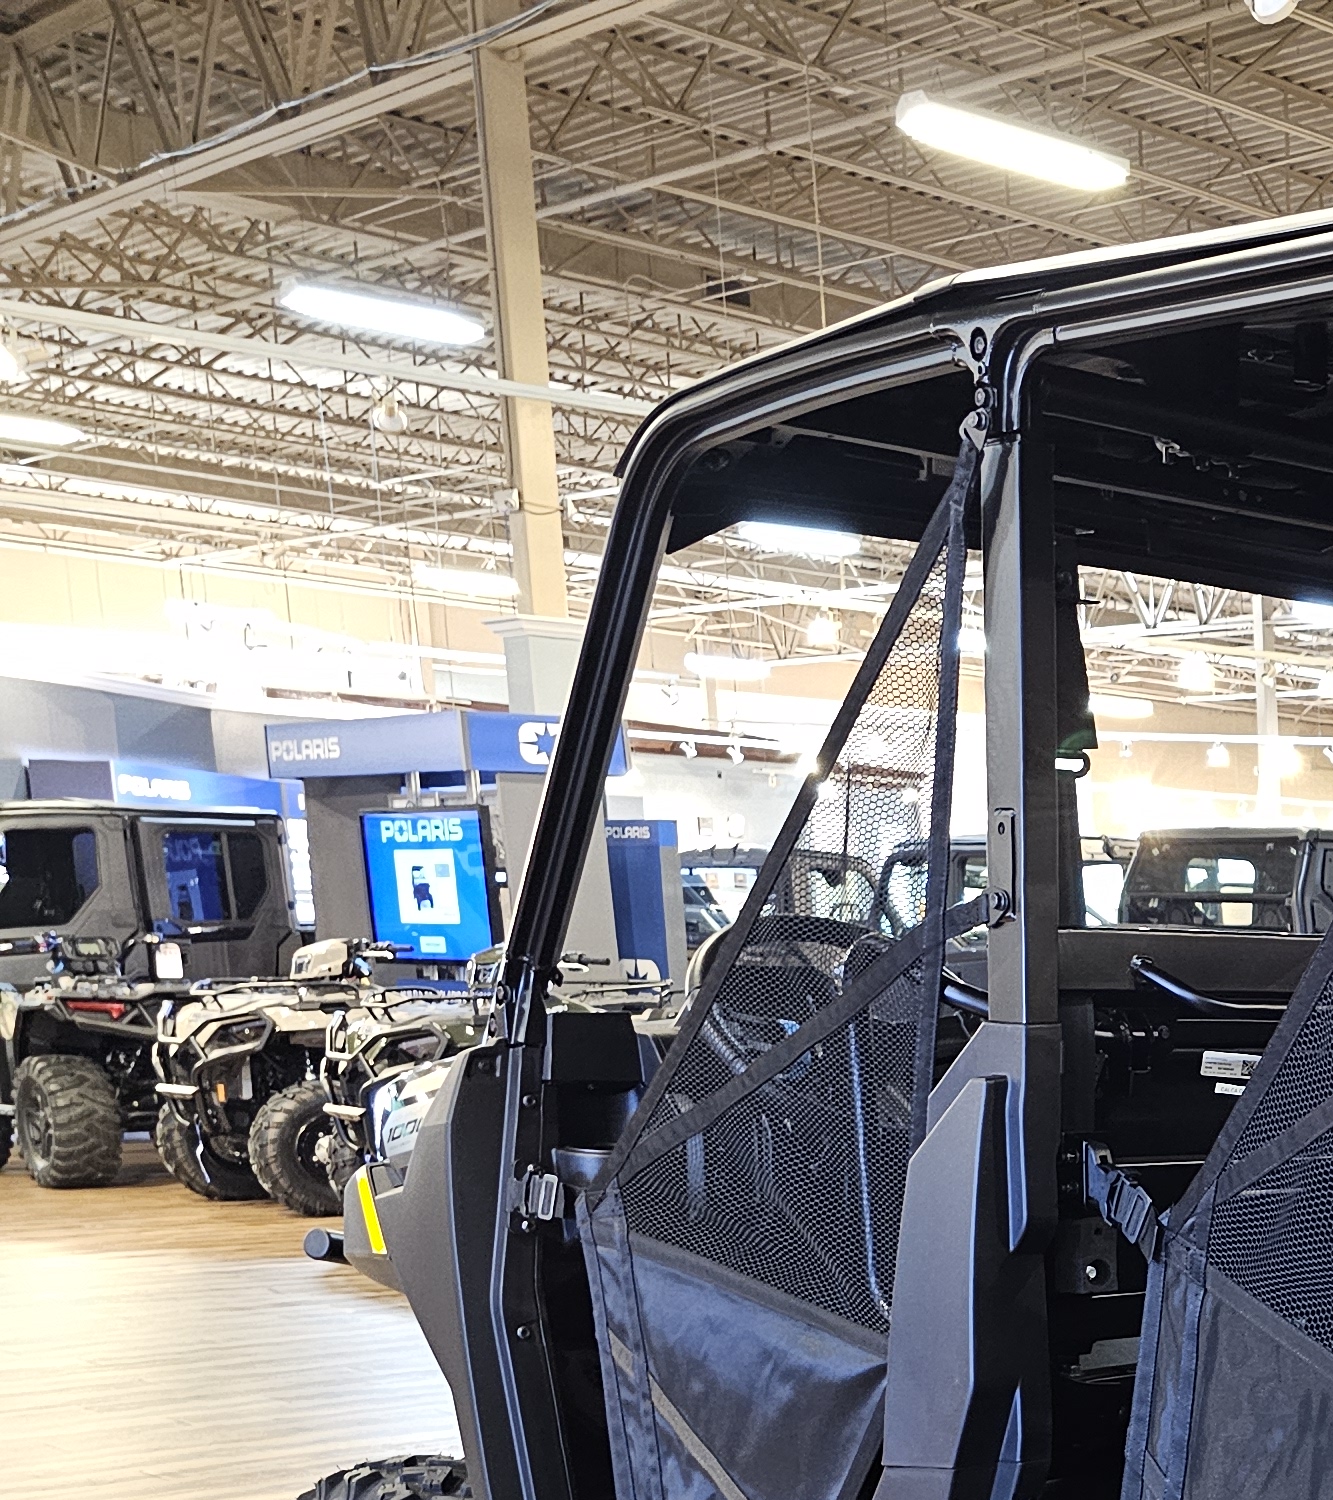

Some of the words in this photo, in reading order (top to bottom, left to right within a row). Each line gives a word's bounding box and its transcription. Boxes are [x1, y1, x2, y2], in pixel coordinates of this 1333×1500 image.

[271, 736, 341, 763] POLARIS
[117, 773, 192, 800] POLARIS
[380, 817, 464, 843] POLARIS
[604, 826, 651, 839] POLARIS
